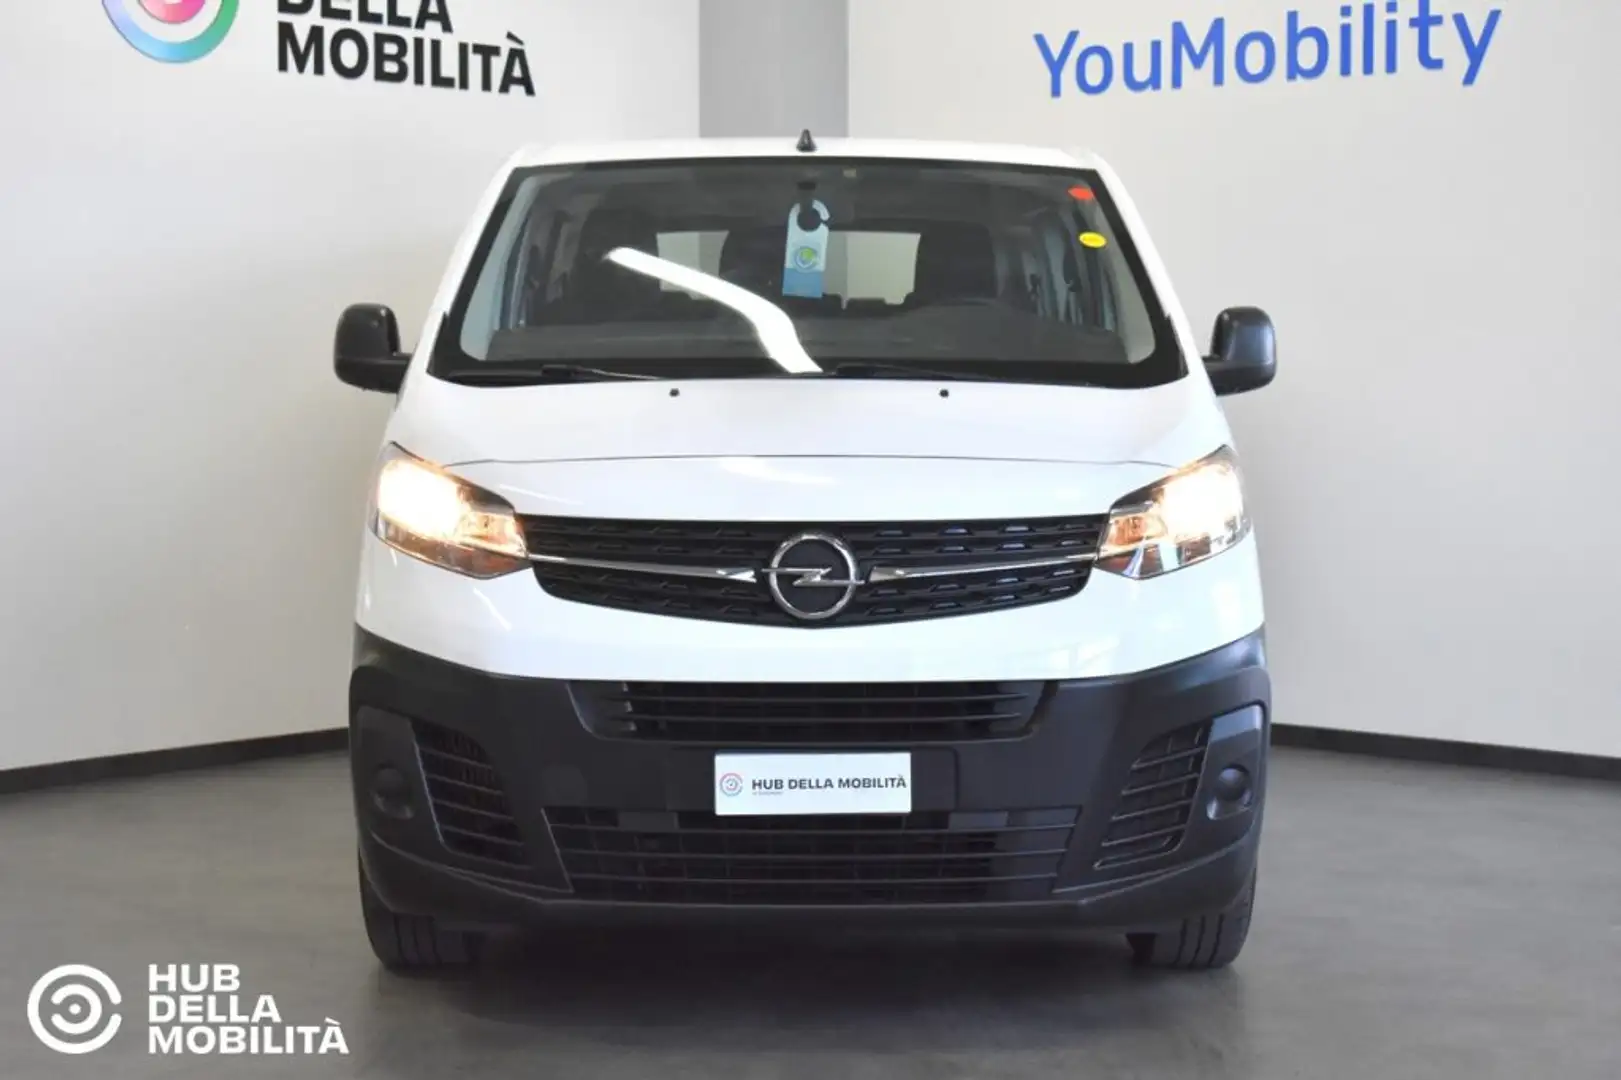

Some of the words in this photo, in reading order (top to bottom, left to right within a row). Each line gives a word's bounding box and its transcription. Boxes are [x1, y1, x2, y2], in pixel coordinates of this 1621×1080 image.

[277, 21, 536, 97] MOBILITÀ
[1034, 0, 1502, 98] YouMobility
[751, 778, 784, 790] HUB
[787, 778, 834, 790] DELLA
[837, 774, 907, 789] MOBILITÀ
